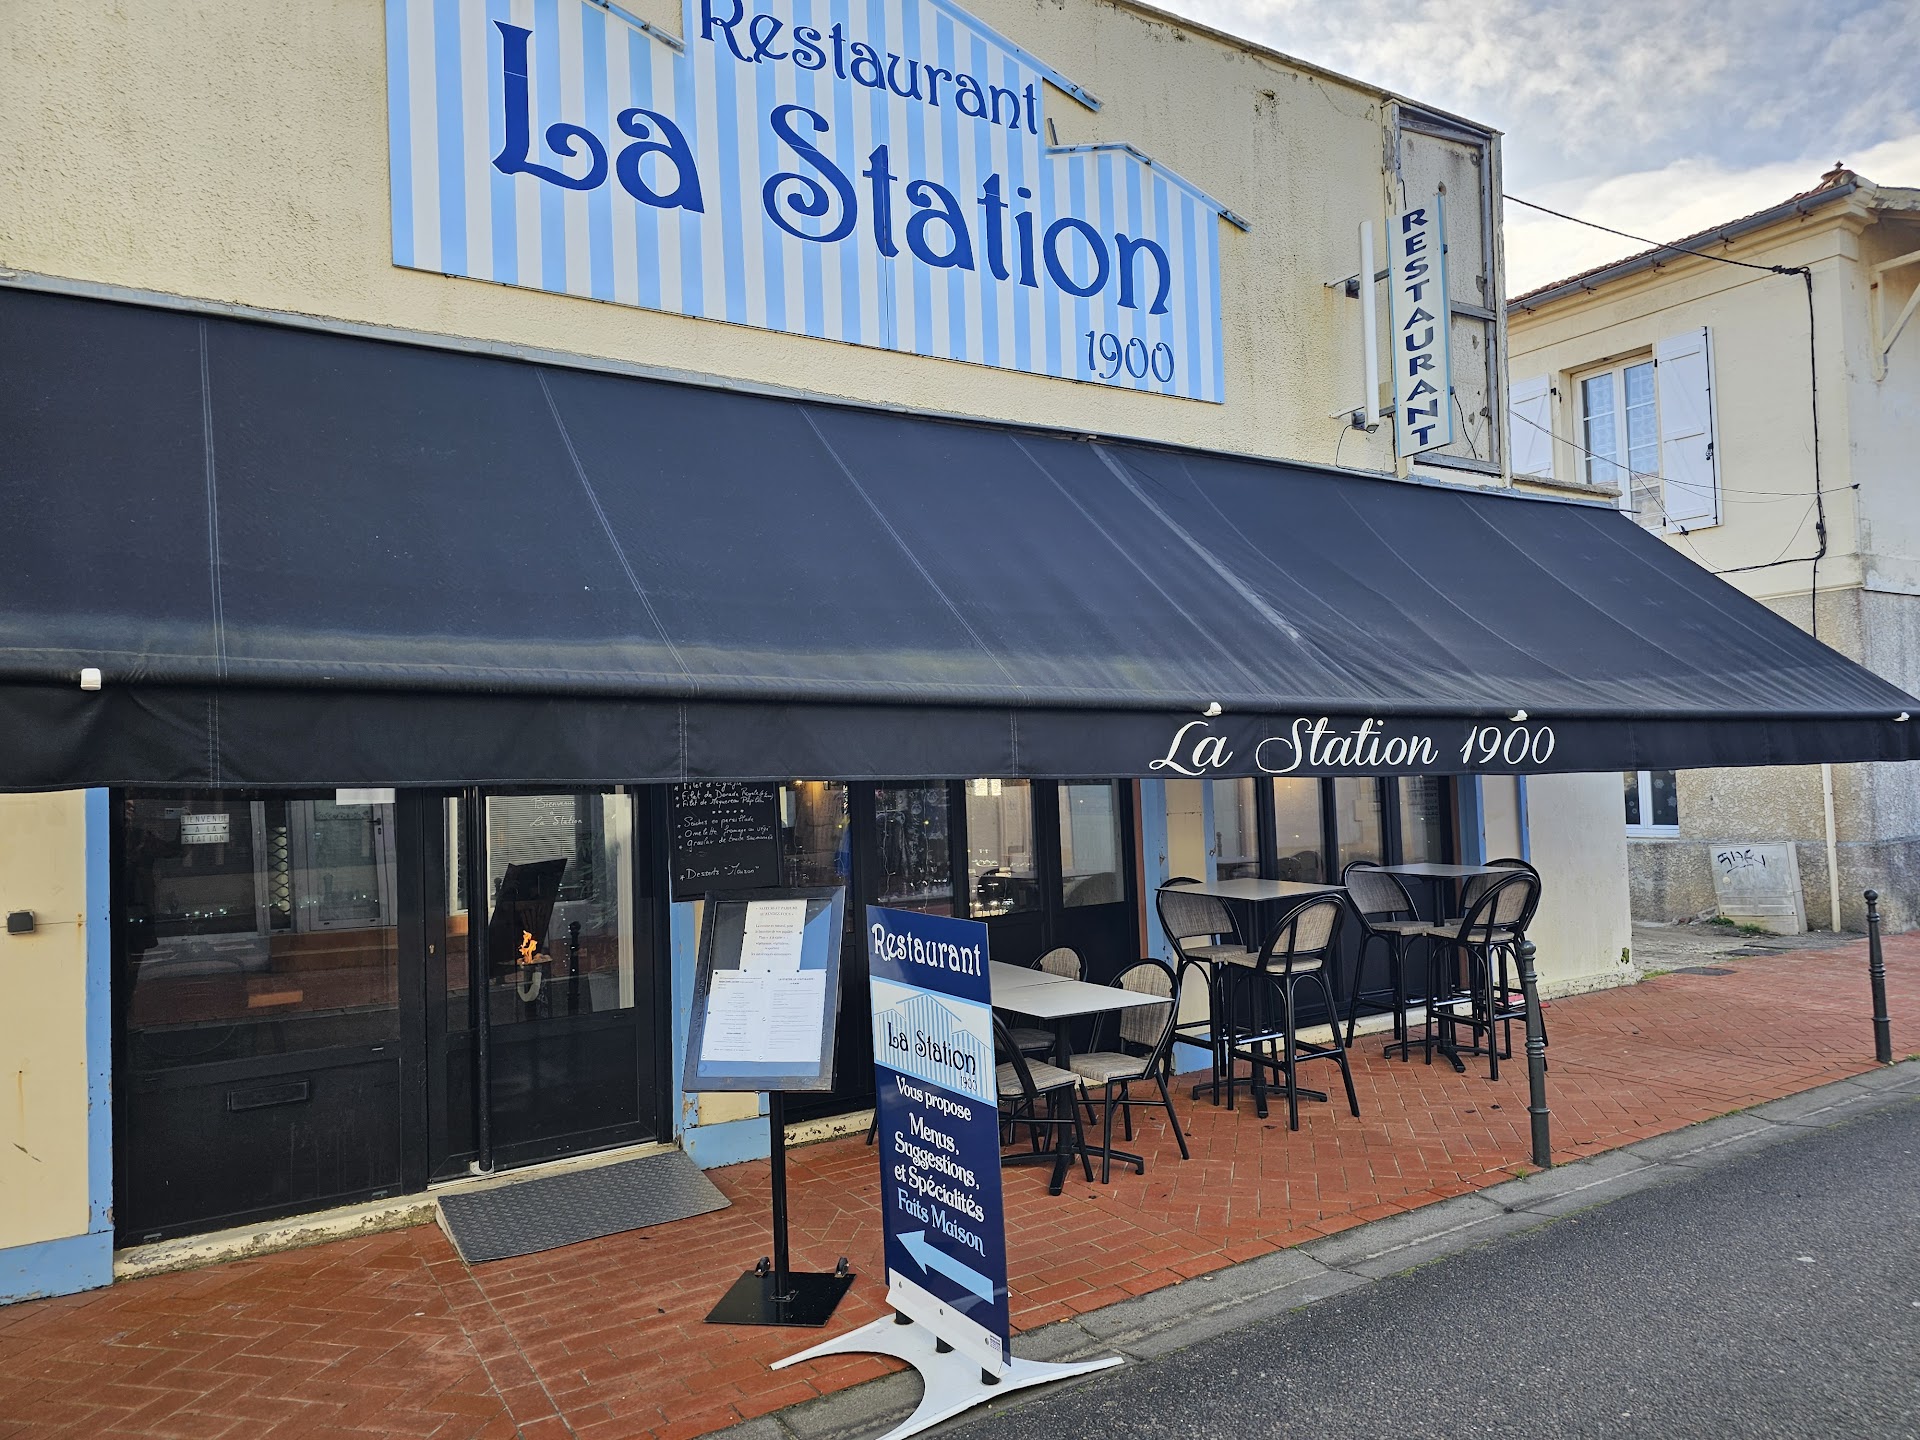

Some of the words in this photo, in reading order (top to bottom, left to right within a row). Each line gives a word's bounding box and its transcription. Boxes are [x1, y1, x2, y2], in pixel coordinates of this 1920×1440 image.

[700, 0, 1038, 134] Restaurant
[492, 19, 705, 214] La
[762, 104, 1171, 315] Station
[1402, 208, 1438, 447] RESTAURANT
[1085, 330, 1175, 383] 1900
[1148, 720, 1233, 777] La
[1255, 716, 1439, 773] Station
[1459, 725, 1556, 765] 1900
[181, 814, 228, 824] BIENVENUE
[184, 834, 225, 843] STATION
[871, 923, 982, 977] Restaurant
[887, 1021, 909, 1052] La
[914, 1029, 977, 1076] Station
[895, 1075, 924, 1103] Vous
[924, 1090, 972, 1121] propose
[894, 1130, 980, 1190] Suggestions,
[908, 1112, 960, 1156] Menus,
[894, 1164, 907, 1183] et
[908, 1165, 985, 1223] Spécialités
[897, 1187, 930, 1224] Faits
[930, 1204, 987, 1258] Maison
